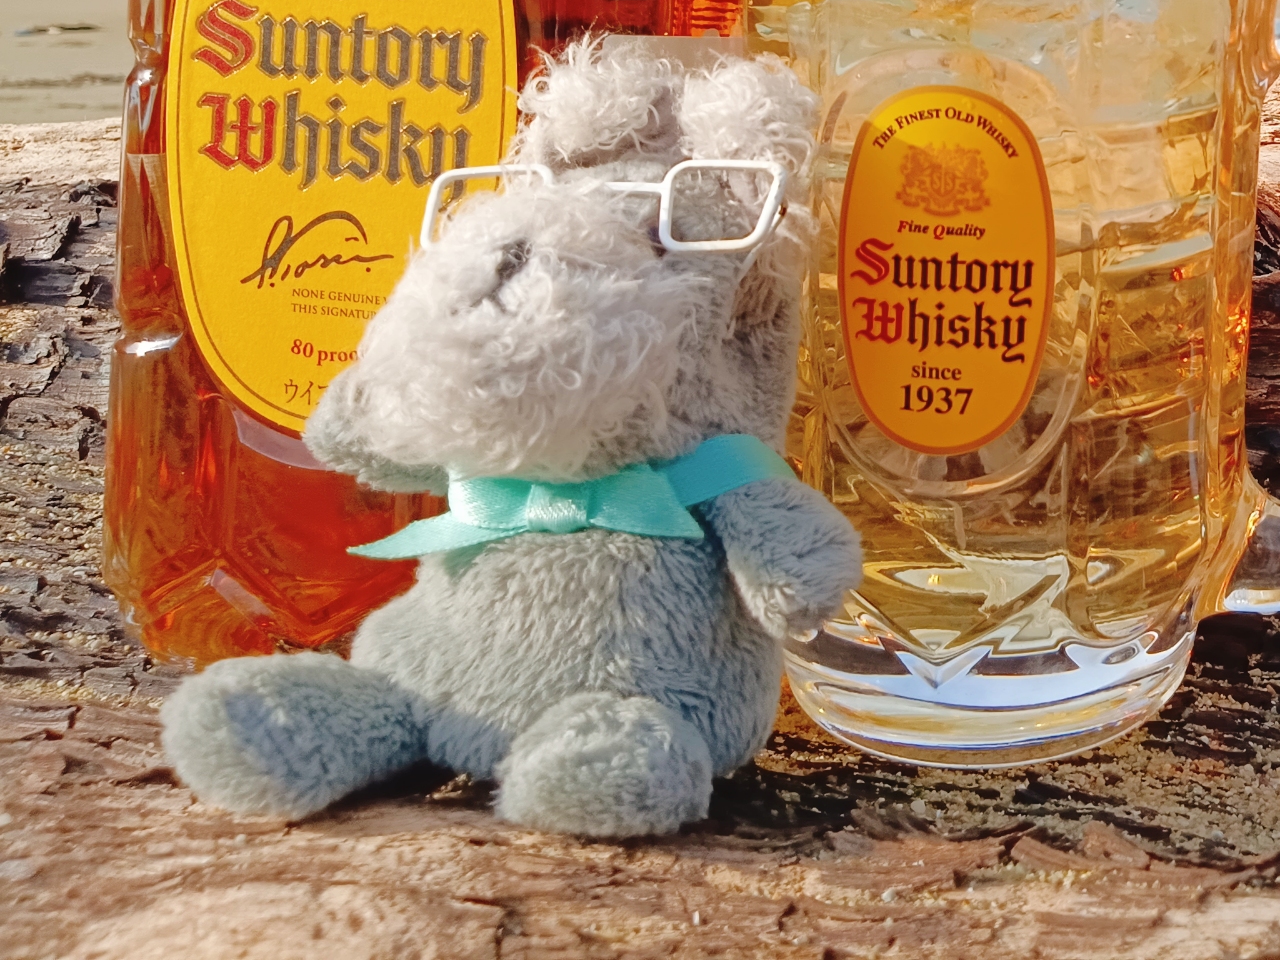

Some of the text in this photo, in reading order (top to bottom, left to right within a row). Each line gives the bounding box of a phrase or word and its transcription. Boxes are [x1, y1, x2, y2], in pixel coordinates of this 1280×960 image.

[872, 106, 1019, 159] THE FINEST OLD WHISKY
[197, 87, 473, 214] Whisky
[897, 220, 986, 240] Fine Quality
[850, 237, 1035, 308] Suntory
[291, 288, 325, 300] NONE
[328, 291, 381, 305] GENUINE
[291, 303, 318, 315] THIS
[852, 295, 1028, 364] Whisky
[290, 338, 359, 366] 80 proo
[911, 361, 963, 381] since
[900, 383, 974, 415] 1937
